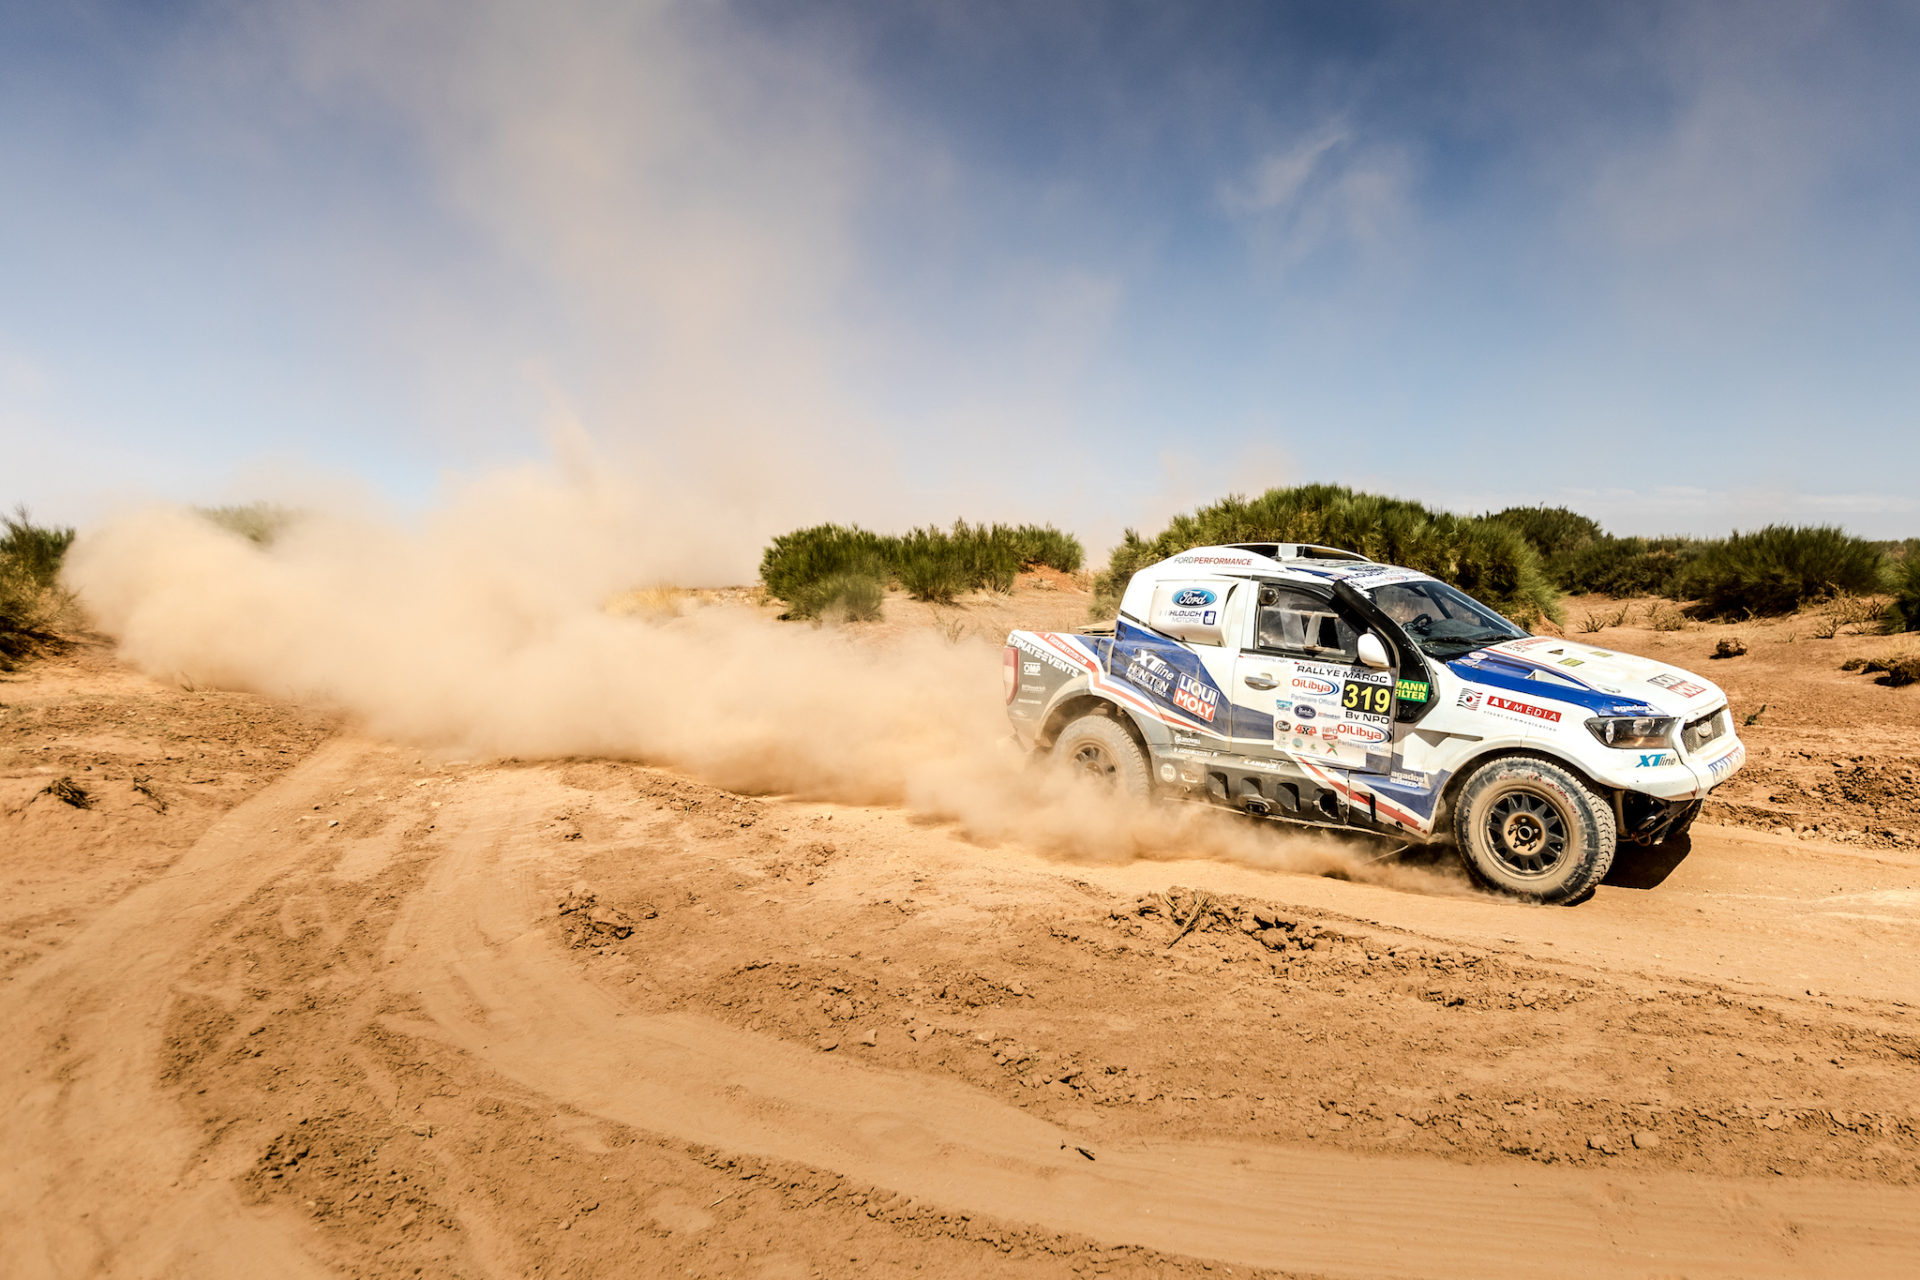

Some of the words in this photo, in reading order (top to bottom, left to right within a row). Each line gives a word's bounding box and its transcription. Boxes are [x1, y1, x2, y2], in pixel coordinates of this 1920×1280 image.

[1179, 590, 1208, 605] Ford
[1024, 665, 1040, 673] OMP
[1133, 649, 1174, 680] XTline
[1297, 665, 1341, 677] RALLYE
[1342, 671, 1388, 684] MAROC
[1180, 675, 1218, 706] LIQUI
[1292, 678, 1332, 692] OiLibya
[1395, 680, 1427, 693] MANN
[1343, 684, 1391, 713] 319
[1394, 689, 1426, 701] FILTER
[1176, 690, 1214, 718] MOLY
[1363, 714, 1390, 725] NPO
[1337, 724, 1382, 740] OiLibya
[1635, 753, 1676, 768] XTline
